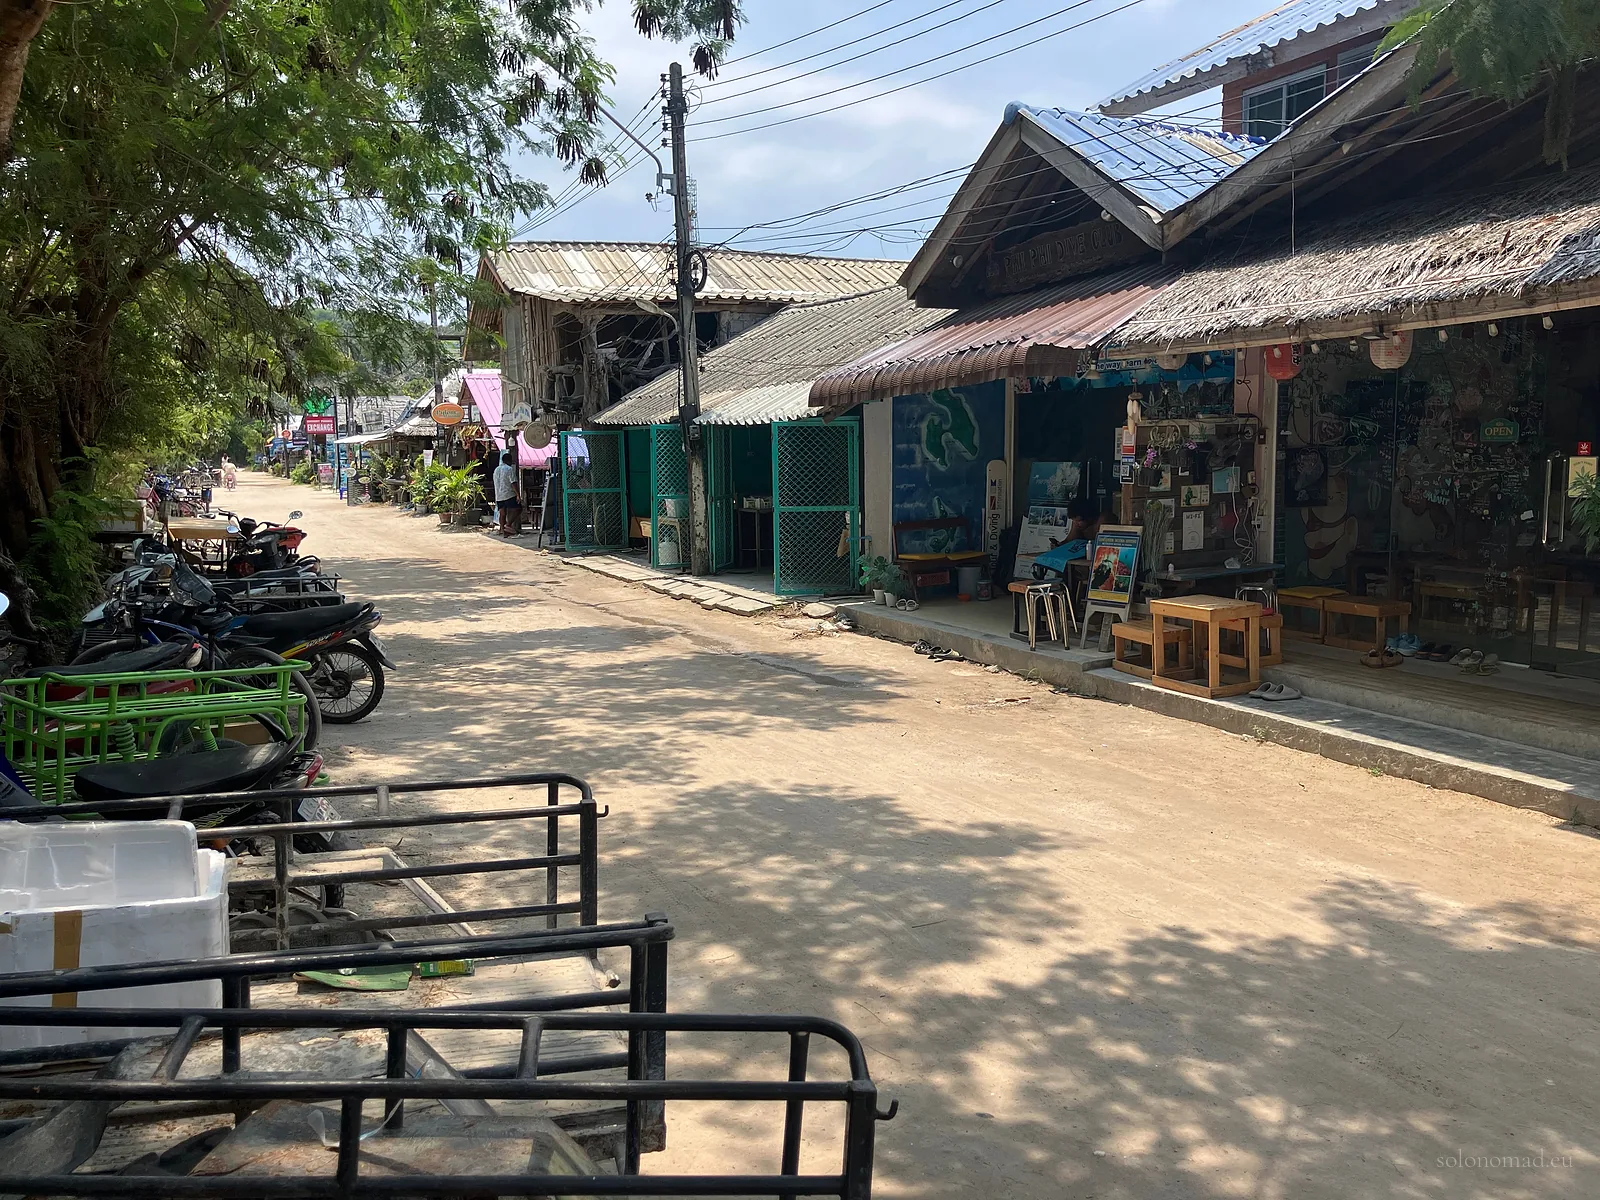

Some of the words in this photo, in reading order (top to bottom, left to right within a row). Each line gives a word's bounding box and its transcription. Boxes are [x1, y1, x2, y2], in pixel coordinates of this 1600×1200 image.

[1029, 243, 1052, 268] PHI
[1056, 233, 1086, 261] DIVE
[307, 423, 334, 432] EXCHANGE
[1485, 427, 1514, 437] OPEN
[990, 513, 1001, 541] Diving
